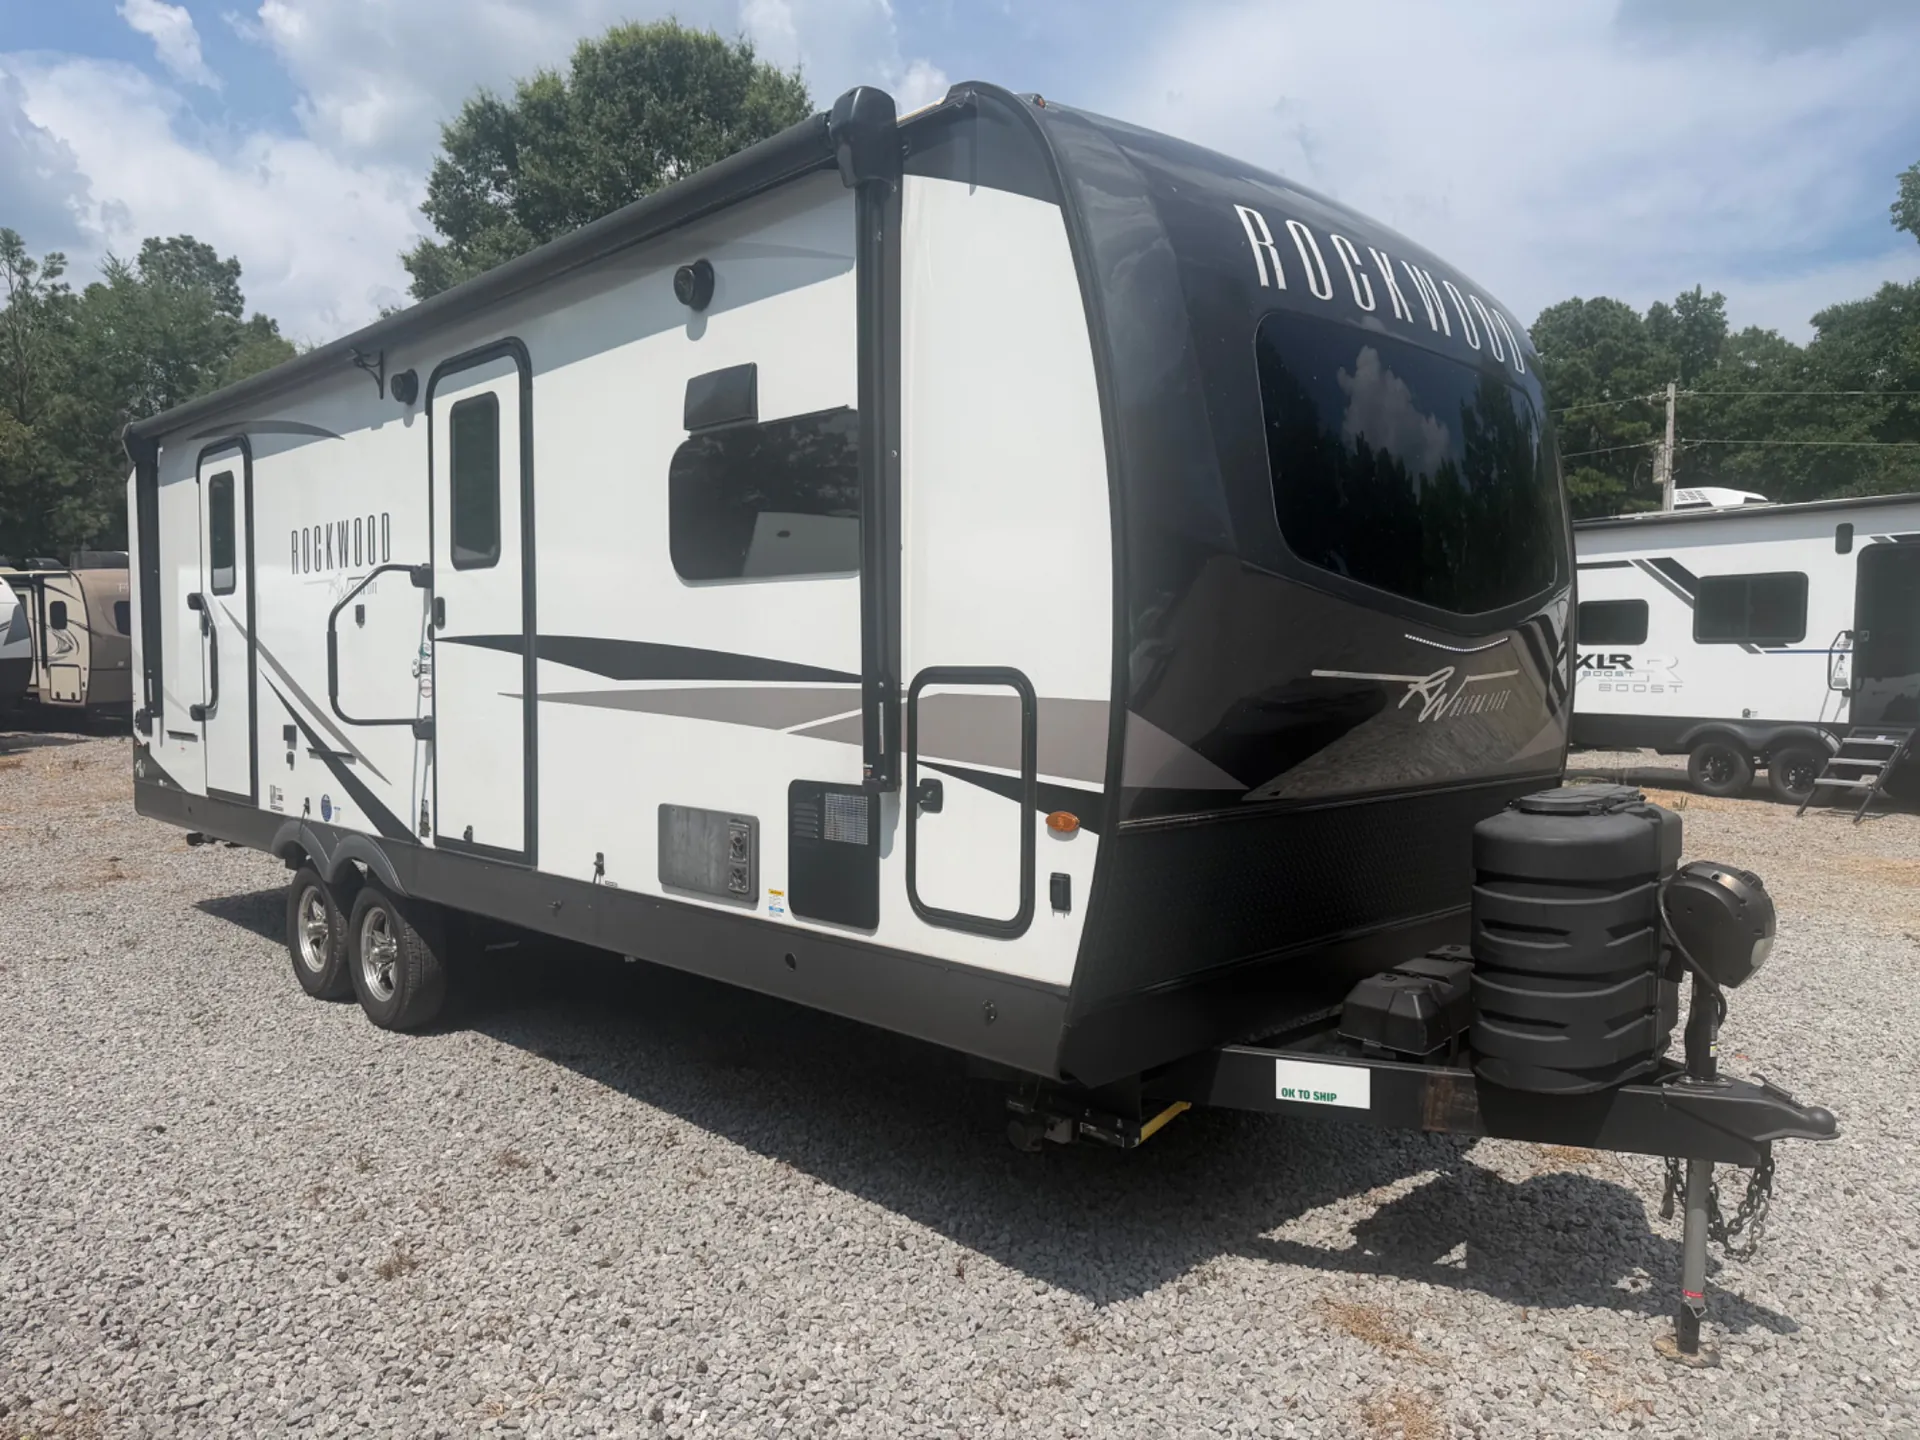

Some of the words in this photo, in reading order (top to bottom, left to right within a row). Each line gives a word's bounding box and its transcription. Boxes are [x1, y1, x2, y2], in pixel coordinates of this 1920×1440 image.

[1234, 204, 1525, 375] ROCKWOOD
[291, 512, 390, 575] ROCKWOOD
[1576, 653, 1634, 670] XLR
[1598, 683, 1683, 693] BOOST
[1281, 1087, 1296, 1098] OK
[1298, 1089, 1311, 1100] TO
[1313, 1091, 1338, 1102] SHIP
